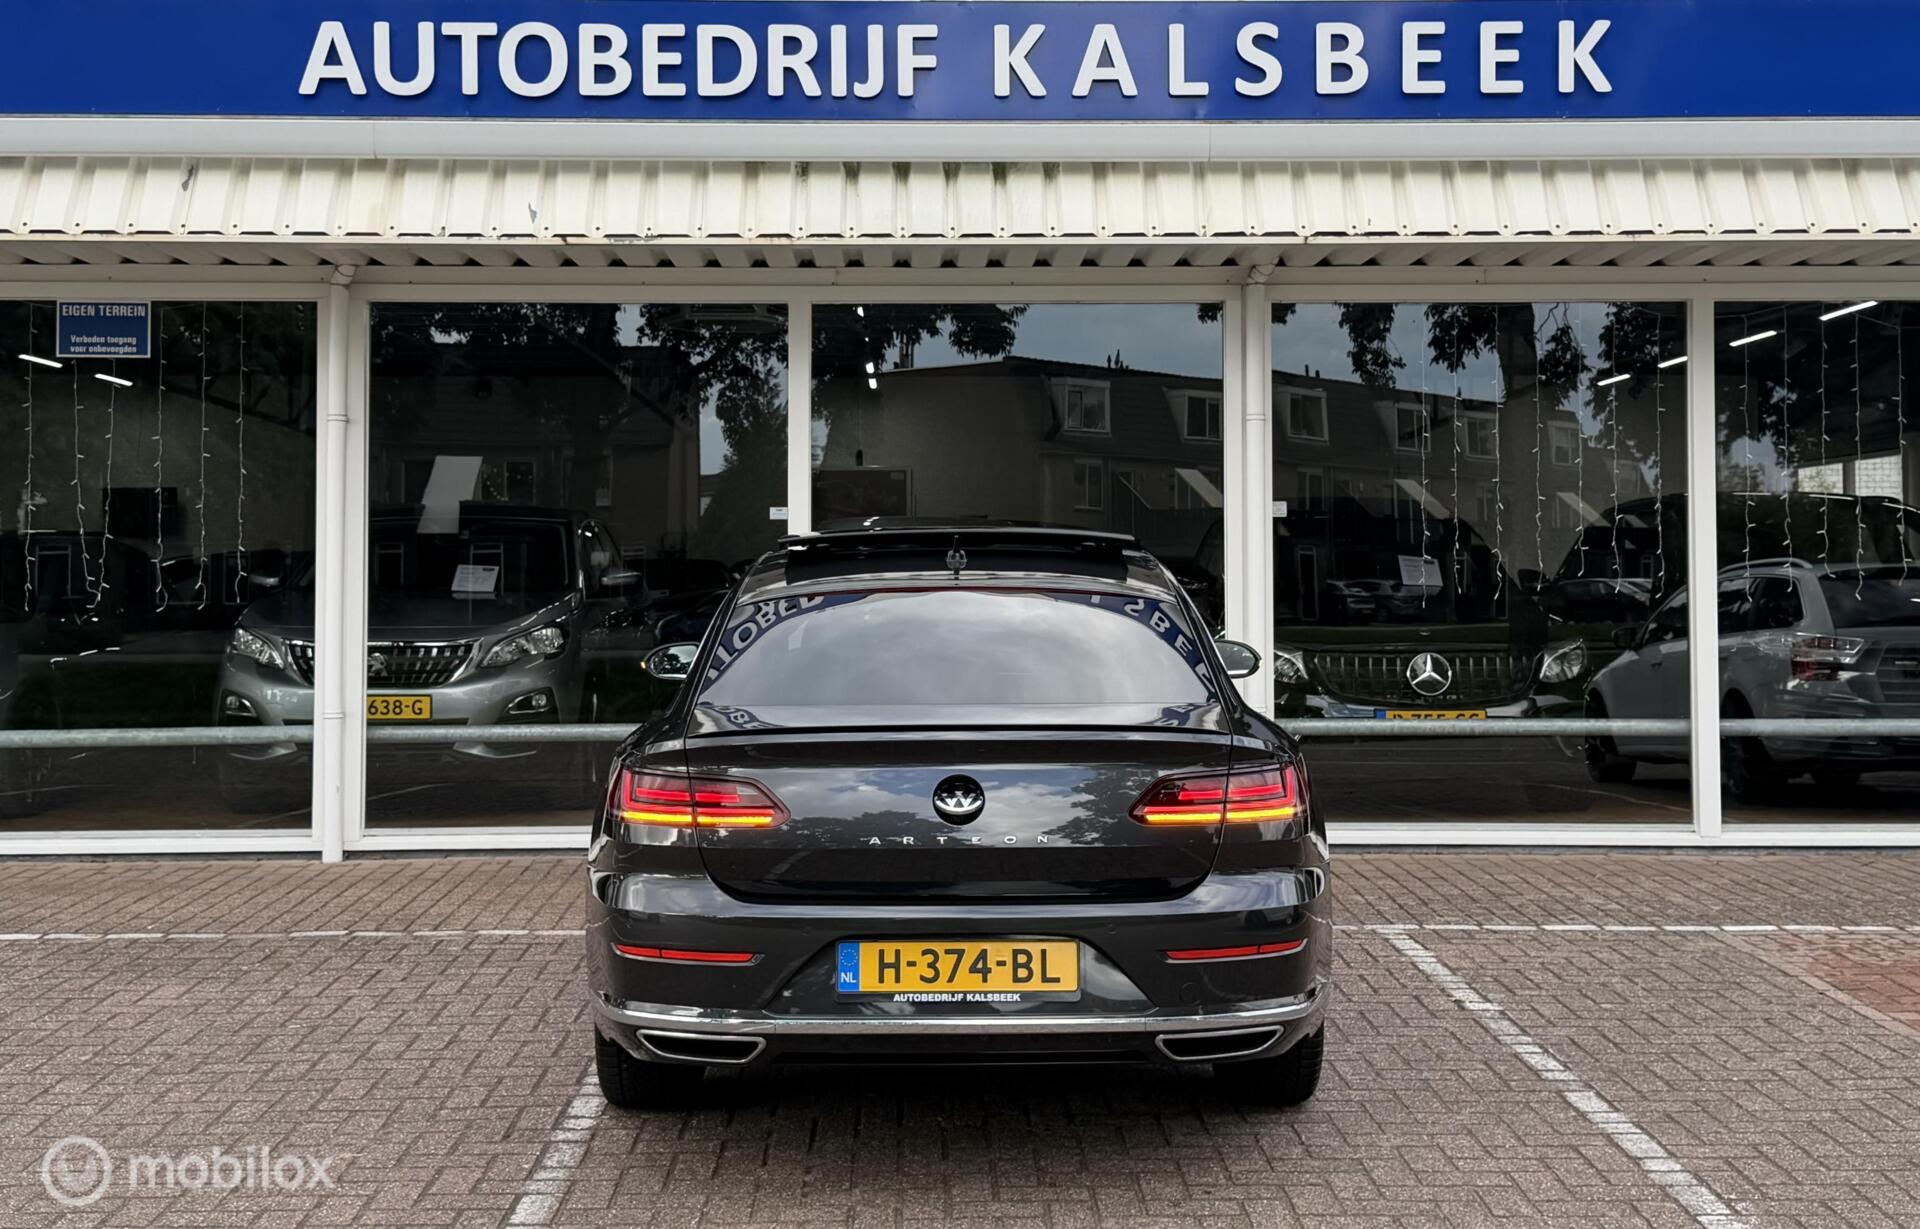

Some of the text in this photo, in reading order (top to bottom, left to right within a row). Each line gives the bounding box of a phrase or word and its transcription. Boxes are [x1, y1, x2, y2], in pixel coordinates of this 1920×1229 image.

[299, 20, 1613, 97] AUTOBEDRIJF KALSBEEK
[62, 304, 146, 317] EIGEN TERREIN
[70, 335, 137, 345] Verboden toegang
[70, 344, 137, 354] voor onbevoegden
[367, 699, 424, 716] 638-G
[868, 835, 1049, 845] ARTEON
[840, 947, 1062, 985] NL H-374-BL
[893, 993, 1021, 1002] AUTOBEDRIJF KALSBEEK
